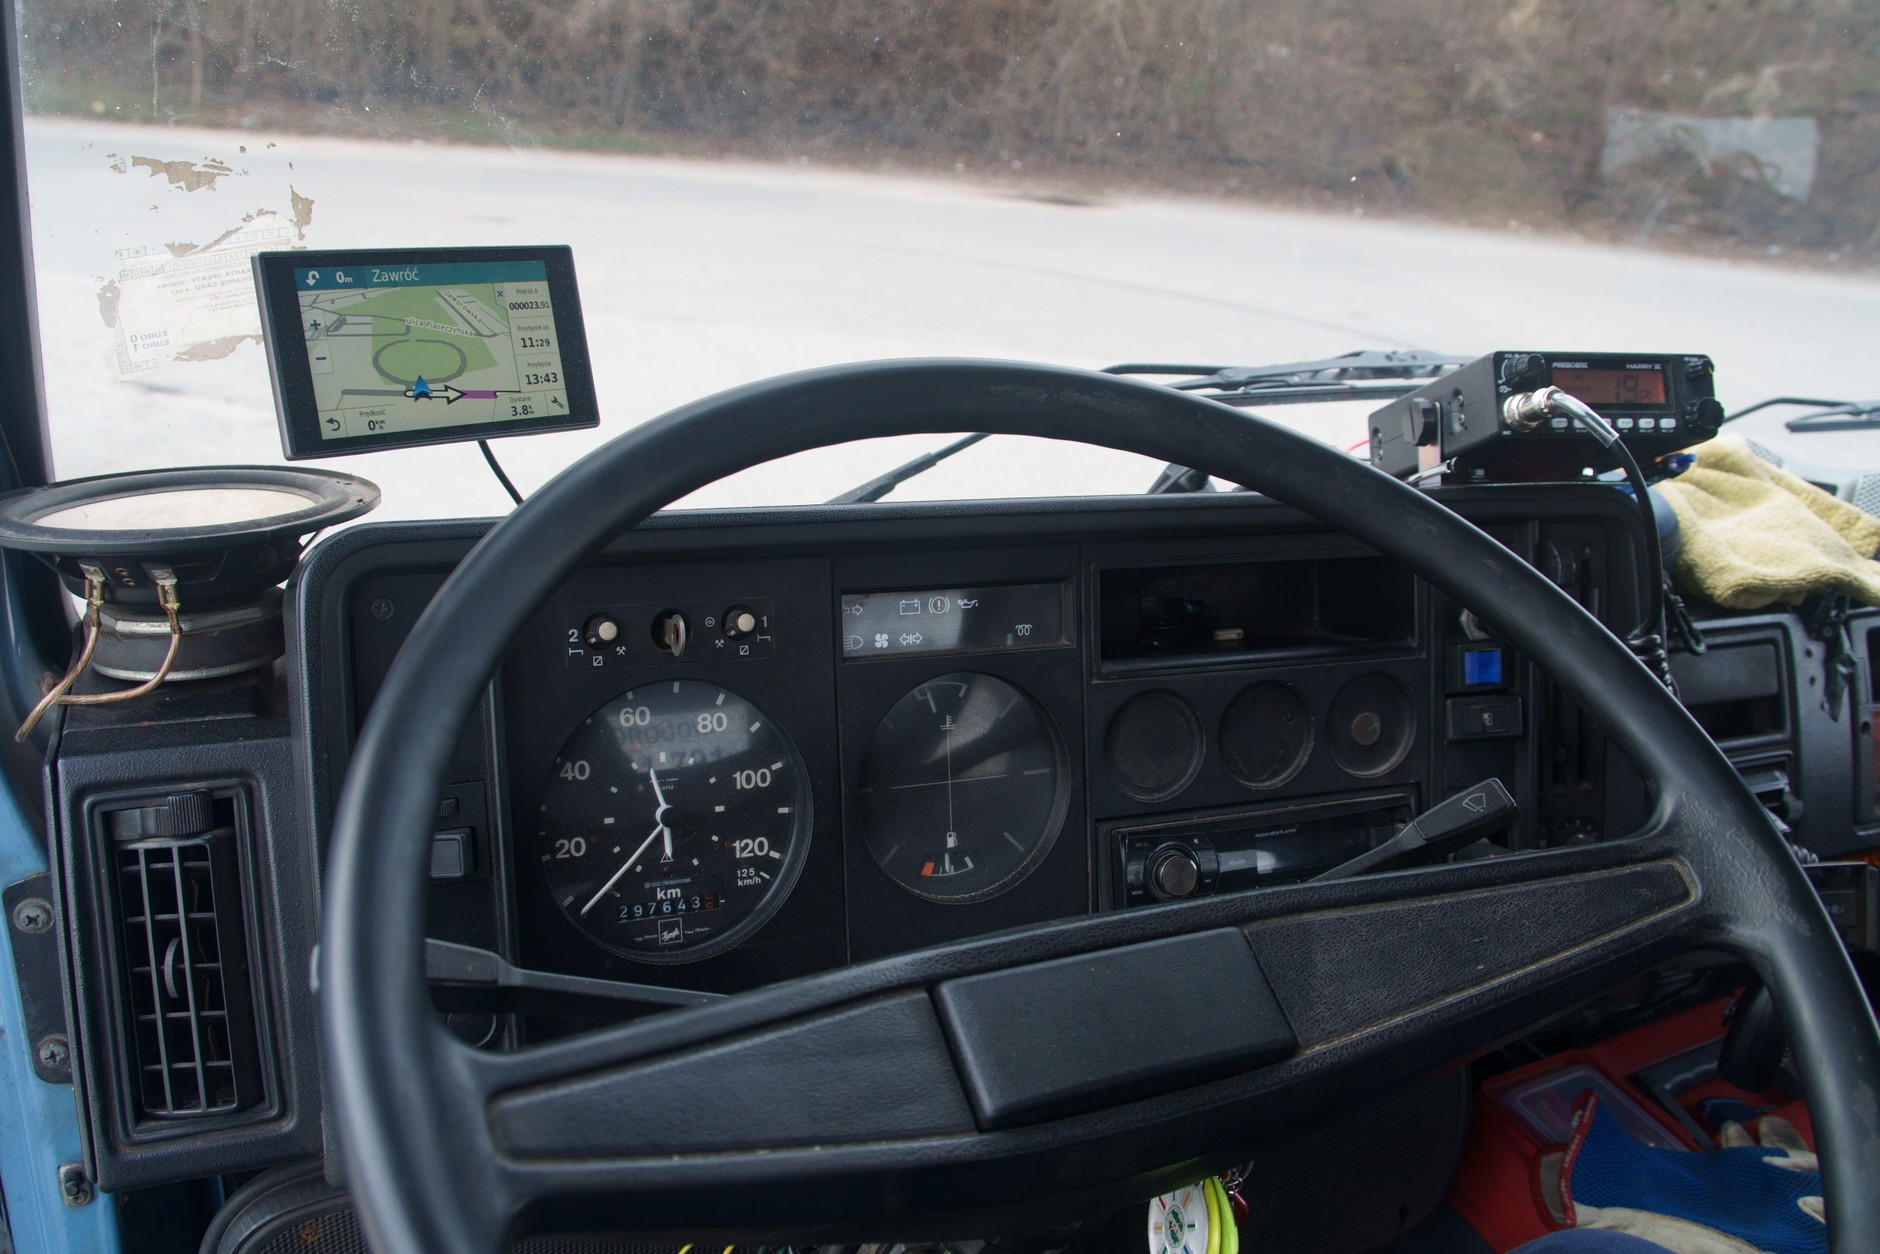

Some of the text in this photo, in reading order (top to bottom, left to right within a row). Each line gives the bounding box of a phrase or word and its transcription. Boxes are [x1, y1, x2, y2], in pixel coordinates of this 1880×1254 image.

[371, 268, 420, 283] Zawróć
[444, 290, 483, 324] Jaworowska
[406, 318, 475, 337] ulica Piaseczyńska
[520, 337, 550, 348] 11:29
[524, 372, 558, 386] 13:43
[510, 404, 529, 417] 3.8
[760, 615, 768, 628] 1
[568, 628, 579, 642] 2
[619, 706, 651, 727] 60
[697, 712, 728, 733] 80
[560, 760, 590, 781] 40
[732, 768, 772, 790] 100
[554, 837, 586, 859] 20
[732, 837, 769, 859] 120
[736, 868, 756, 878] 125
[737, 876, 762, 887] km/h
[656, 886, 682, 900] km
